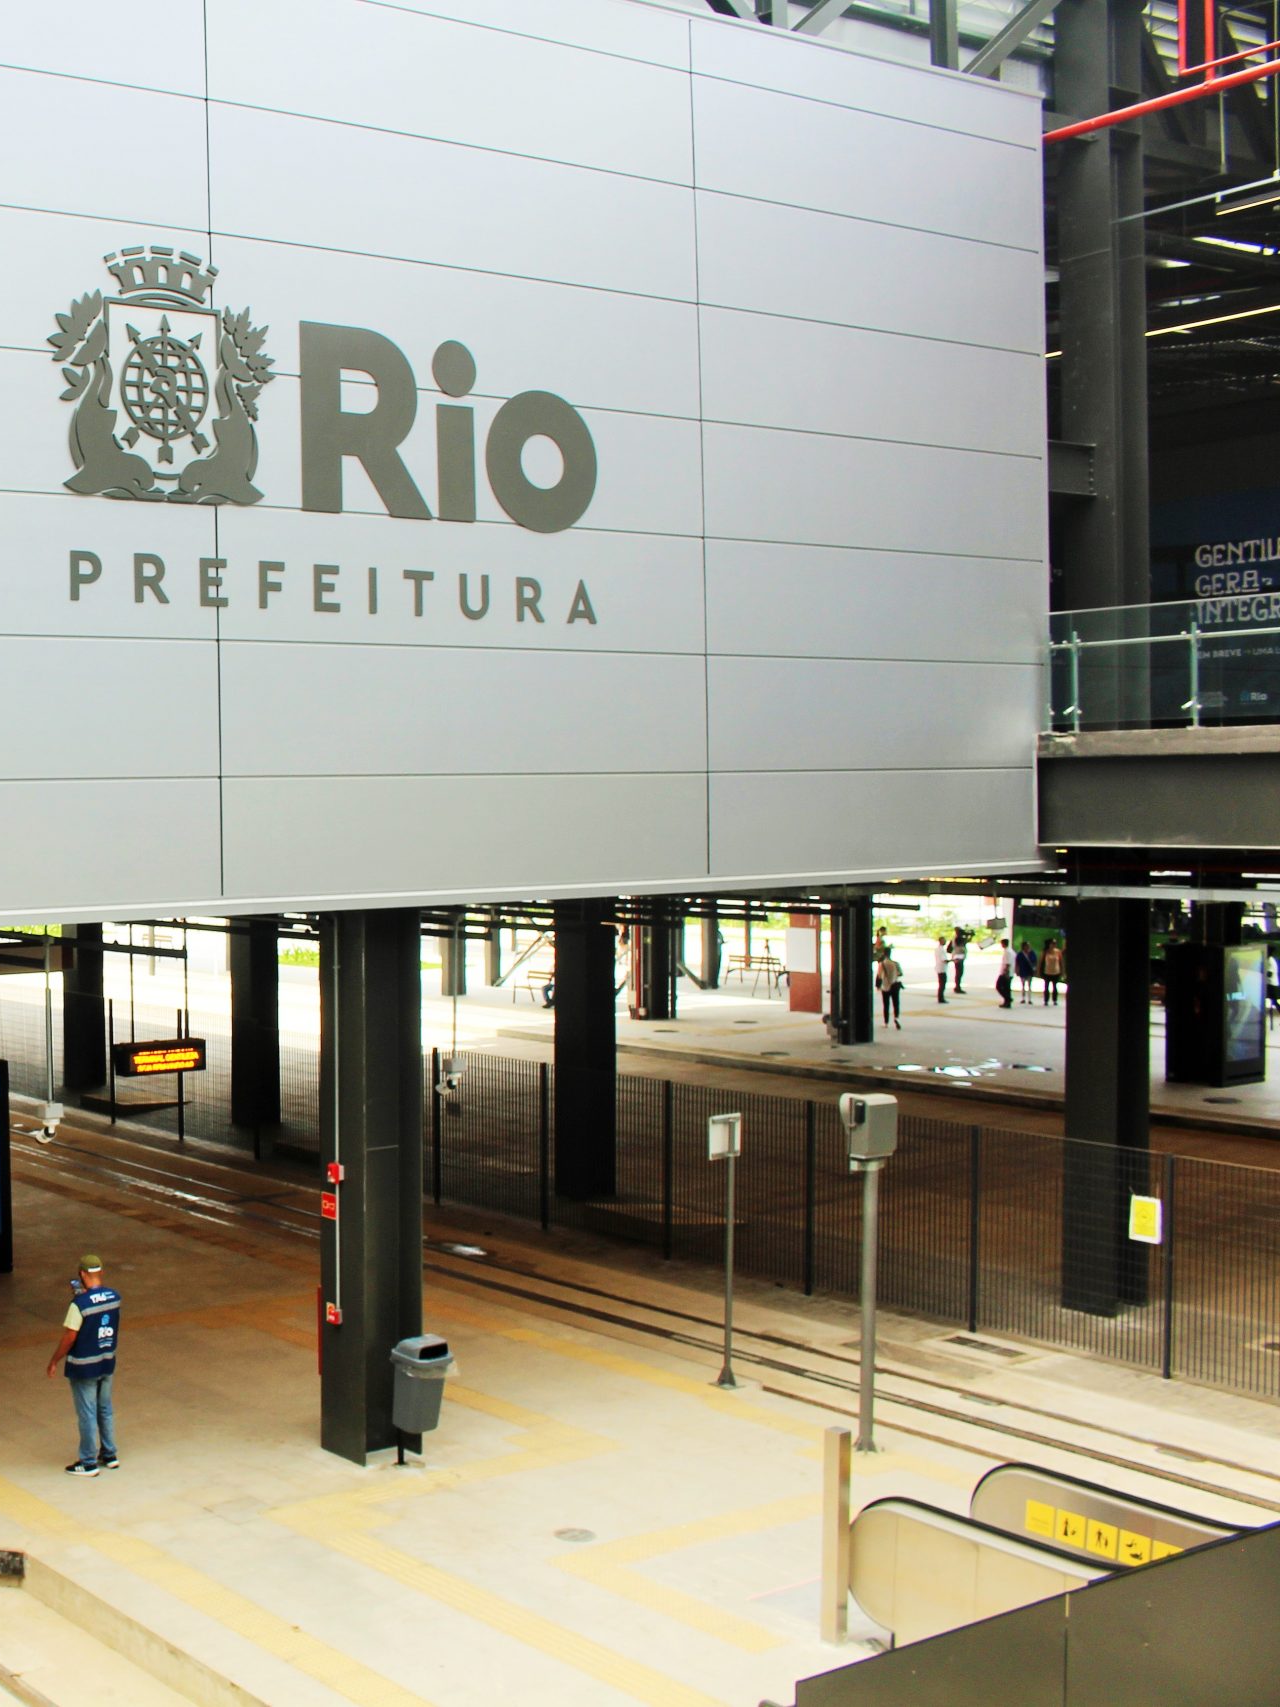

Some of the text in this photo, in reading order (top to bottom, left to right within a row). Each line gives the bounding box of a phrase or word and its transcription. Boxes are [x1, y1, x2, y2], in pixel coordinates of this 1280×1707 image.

[299, 320, 599, 535] Rio
[1195, 537, 1280, 568] GENTIL
[70, 550, 599, 626] PREFEITURA
[1195, 569, 1260, 597] GERA
